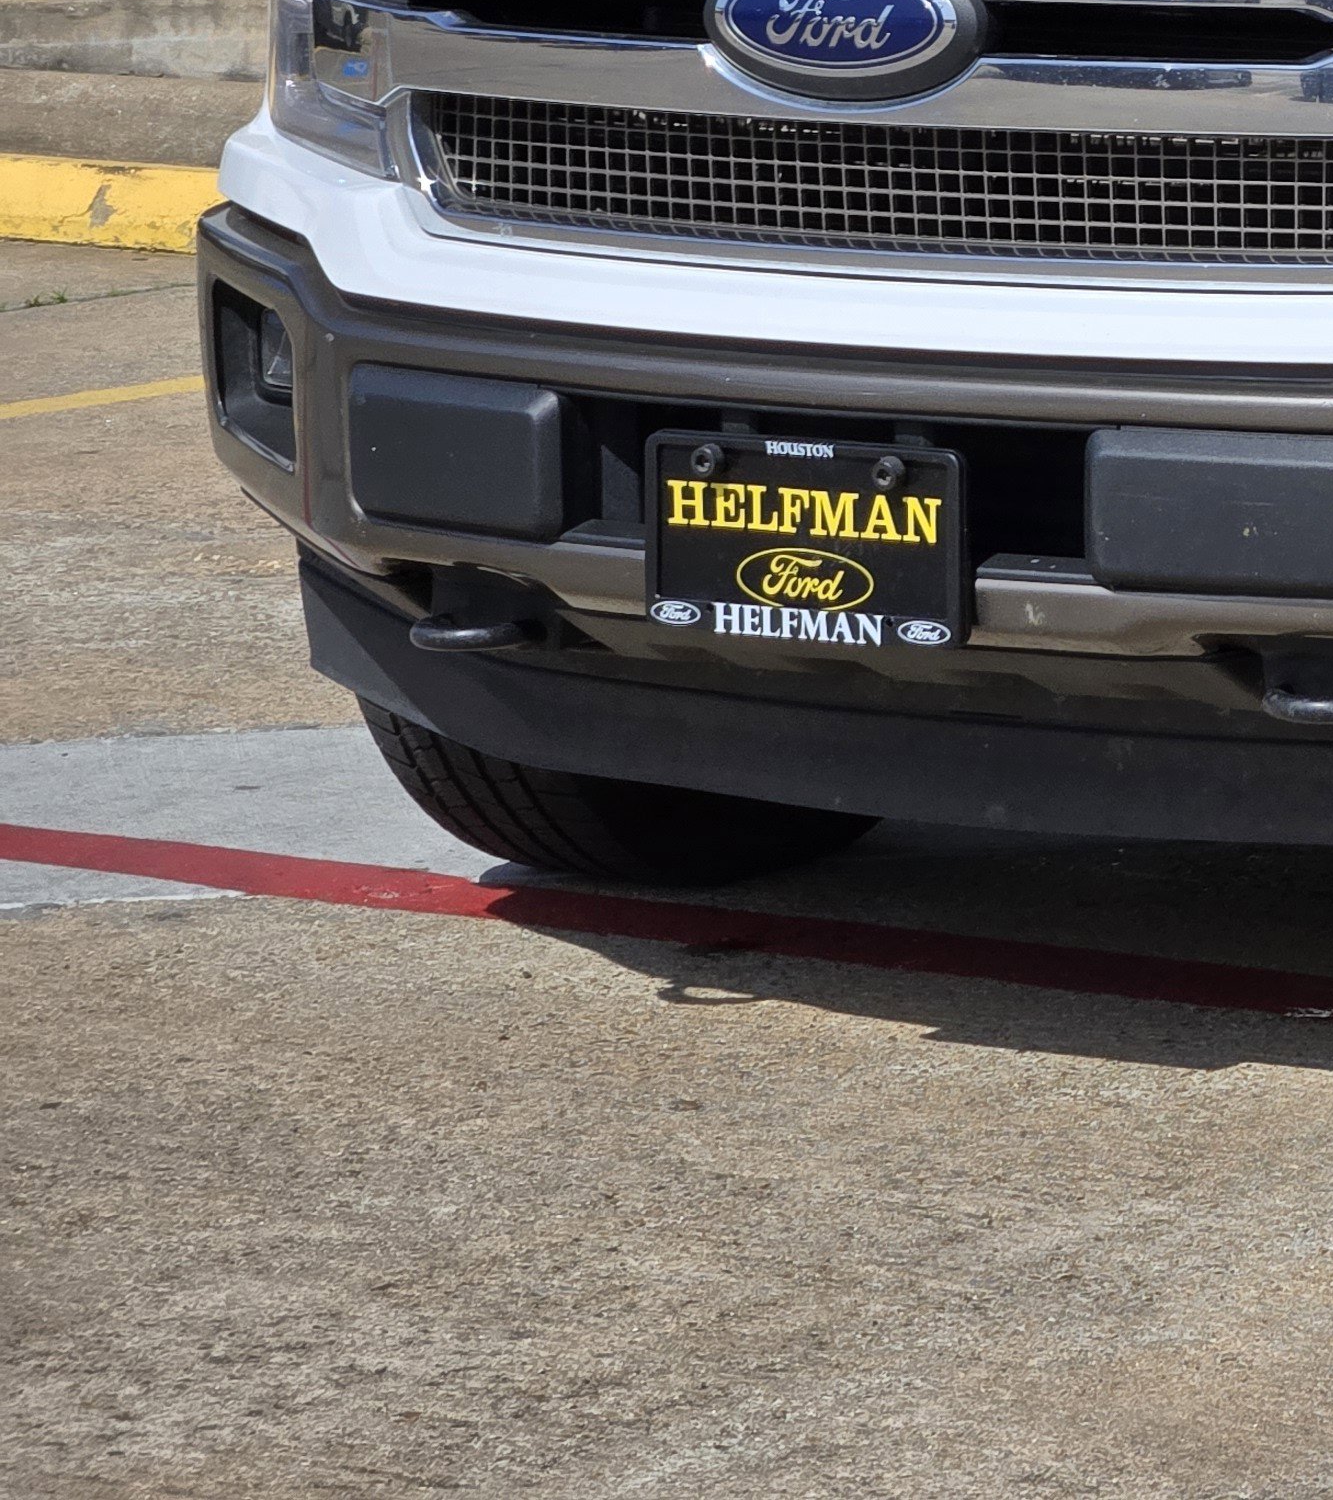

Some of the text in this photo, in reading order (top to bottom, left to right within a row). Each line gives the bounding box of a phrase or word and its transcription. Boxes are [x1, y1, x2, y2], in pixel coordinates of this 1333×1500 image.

[764, 440, 834, 459] HOUSTON
[666, 479, 942, 544] HELFMAN
[762, 554, 844, 601] Ford
[659, 603, 692, 622] Ford
[713, 602, 884, 647] HELFMAN
[907, 622, 941, 642] Ford
